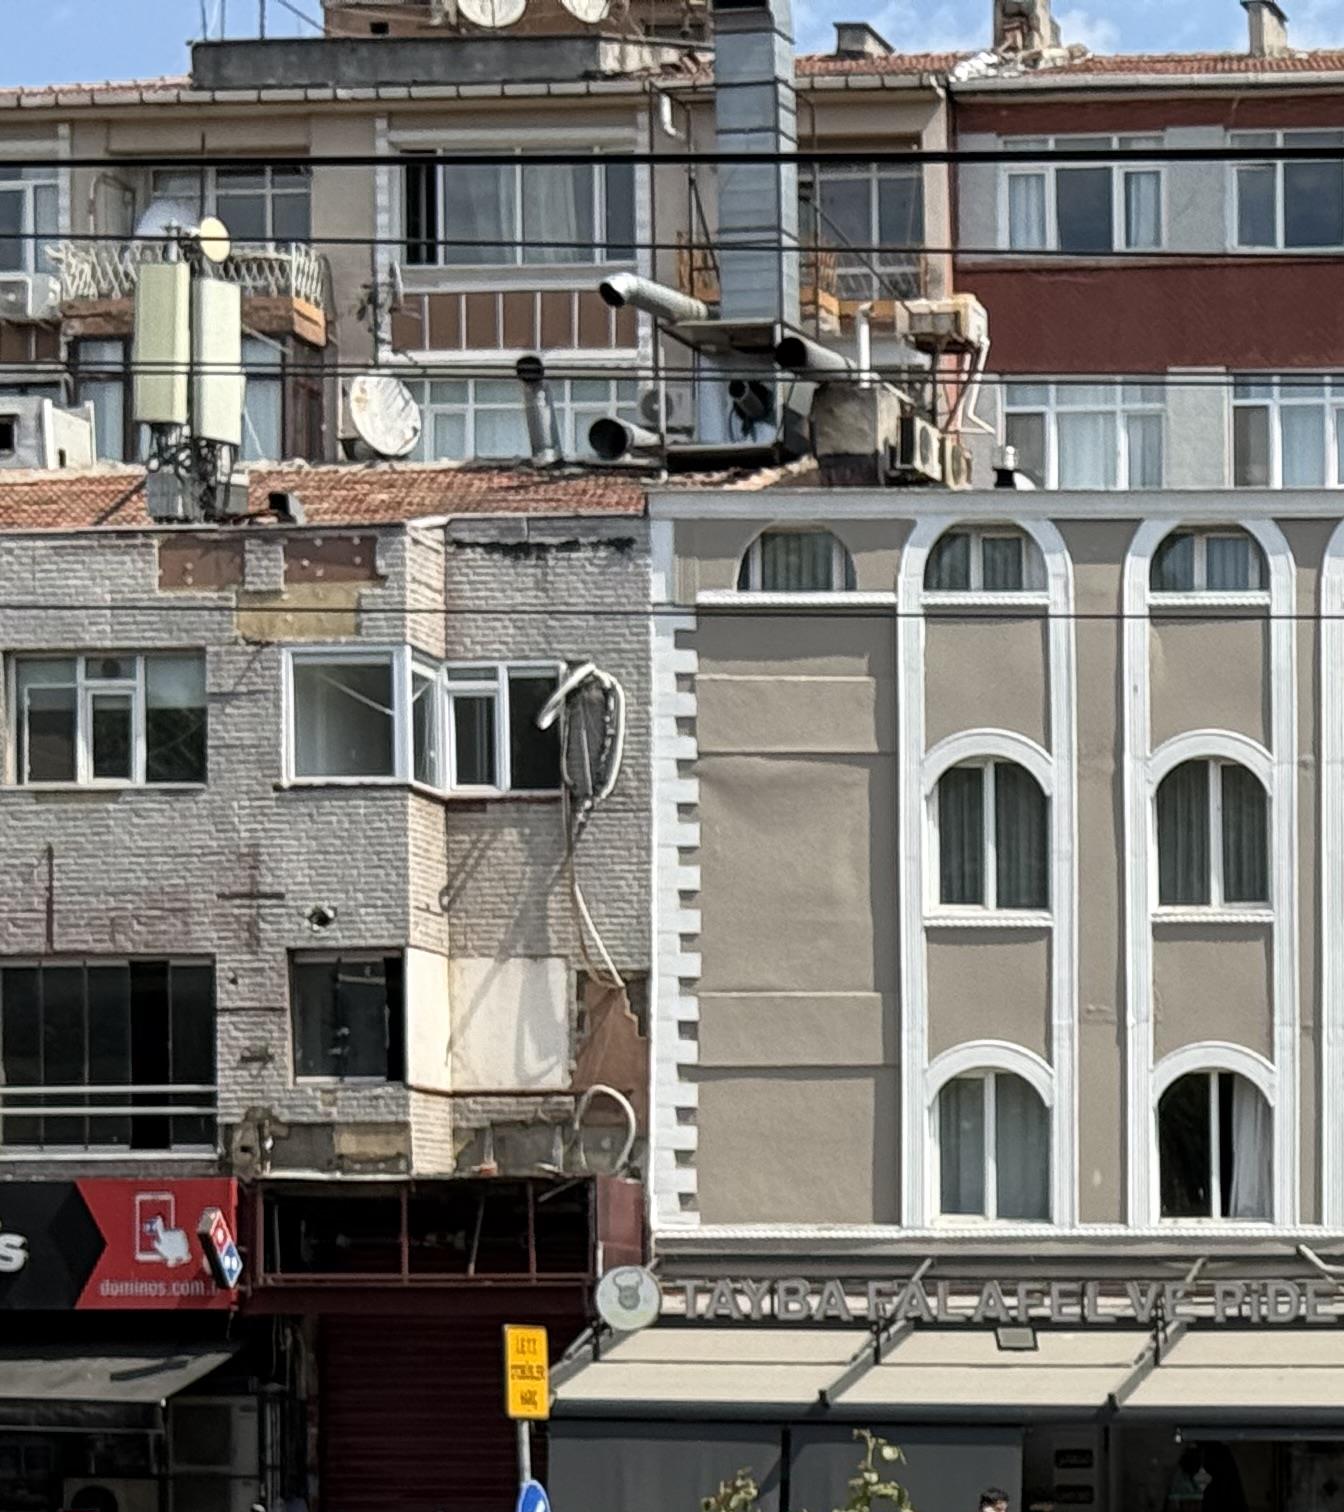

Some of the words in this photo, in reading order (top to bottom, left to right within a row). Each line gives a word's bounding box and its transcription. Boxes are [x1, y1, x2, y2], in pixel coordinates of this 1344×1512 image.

[676, 1279, 853, 1321] TAYBA
[867, 1279, 1117, 1324] FALAFEL
[1126, 1281, 1197, 1323] VE
